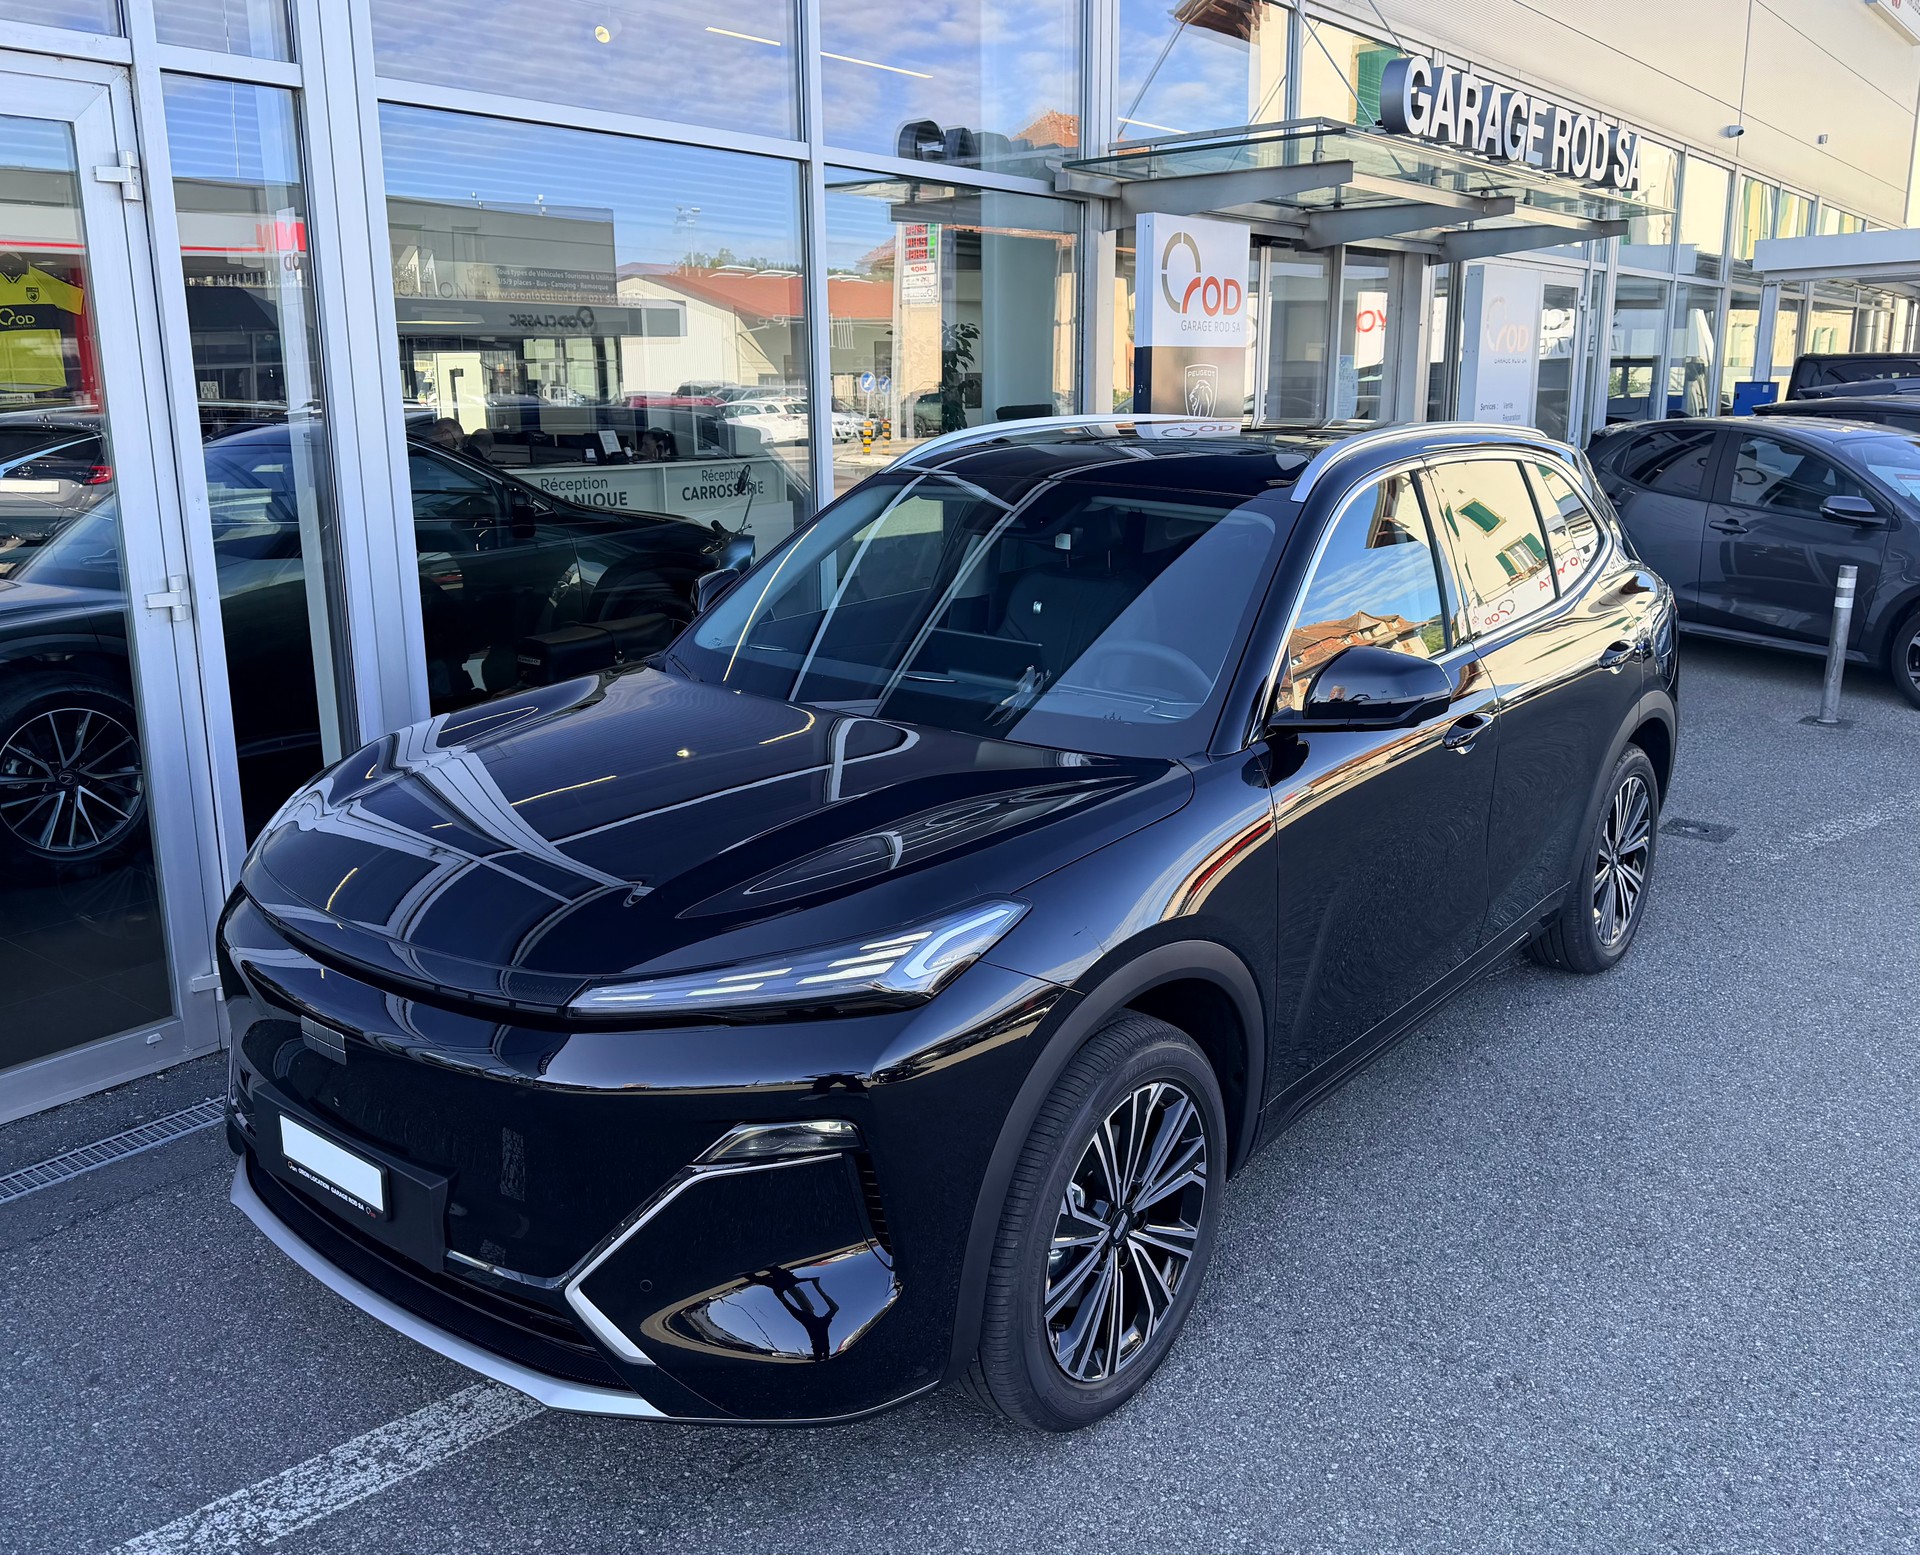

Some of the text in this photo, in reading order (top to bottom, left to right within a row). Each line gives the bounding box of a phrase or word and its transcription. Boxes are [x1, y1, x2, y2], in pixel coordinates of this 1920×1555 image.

[1402, 55, 1642, 191] GARAGE ROD SA
[1180, 319, 1241, 333] GARAGE ROD SA
[1187, 369, 1216, 378] PEUGEOT
[540, 476, 608, 493] Réception
